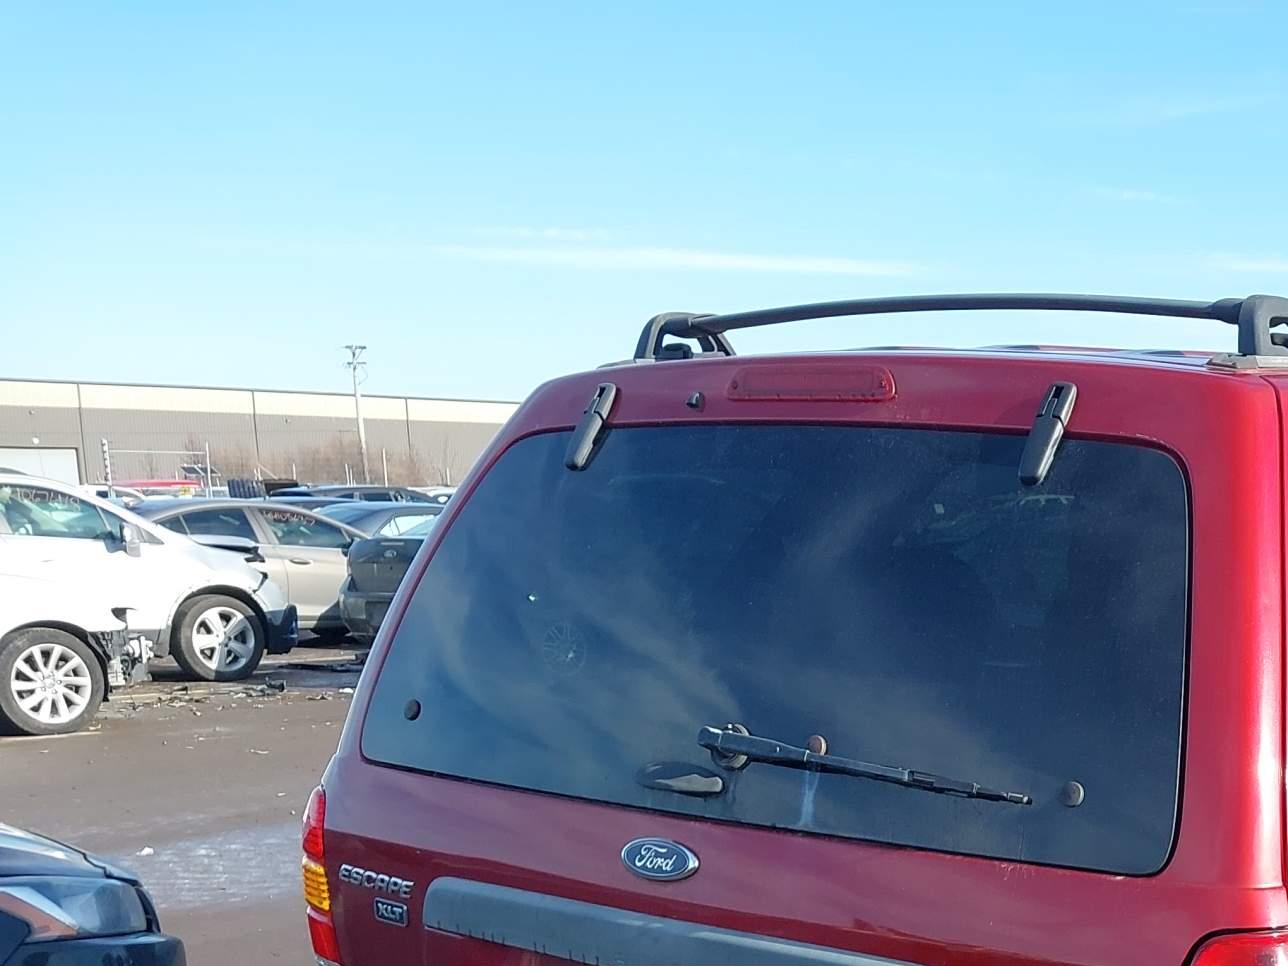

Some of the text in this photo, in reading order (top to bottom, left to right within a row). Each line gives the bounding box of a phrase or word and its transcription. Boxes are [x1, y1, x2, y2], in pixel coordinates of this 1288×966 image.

[635, 844, 677, 871] Ford
[339, 863, 415, 898] ESCAPE
[377, 902, 403, 921] XLT
